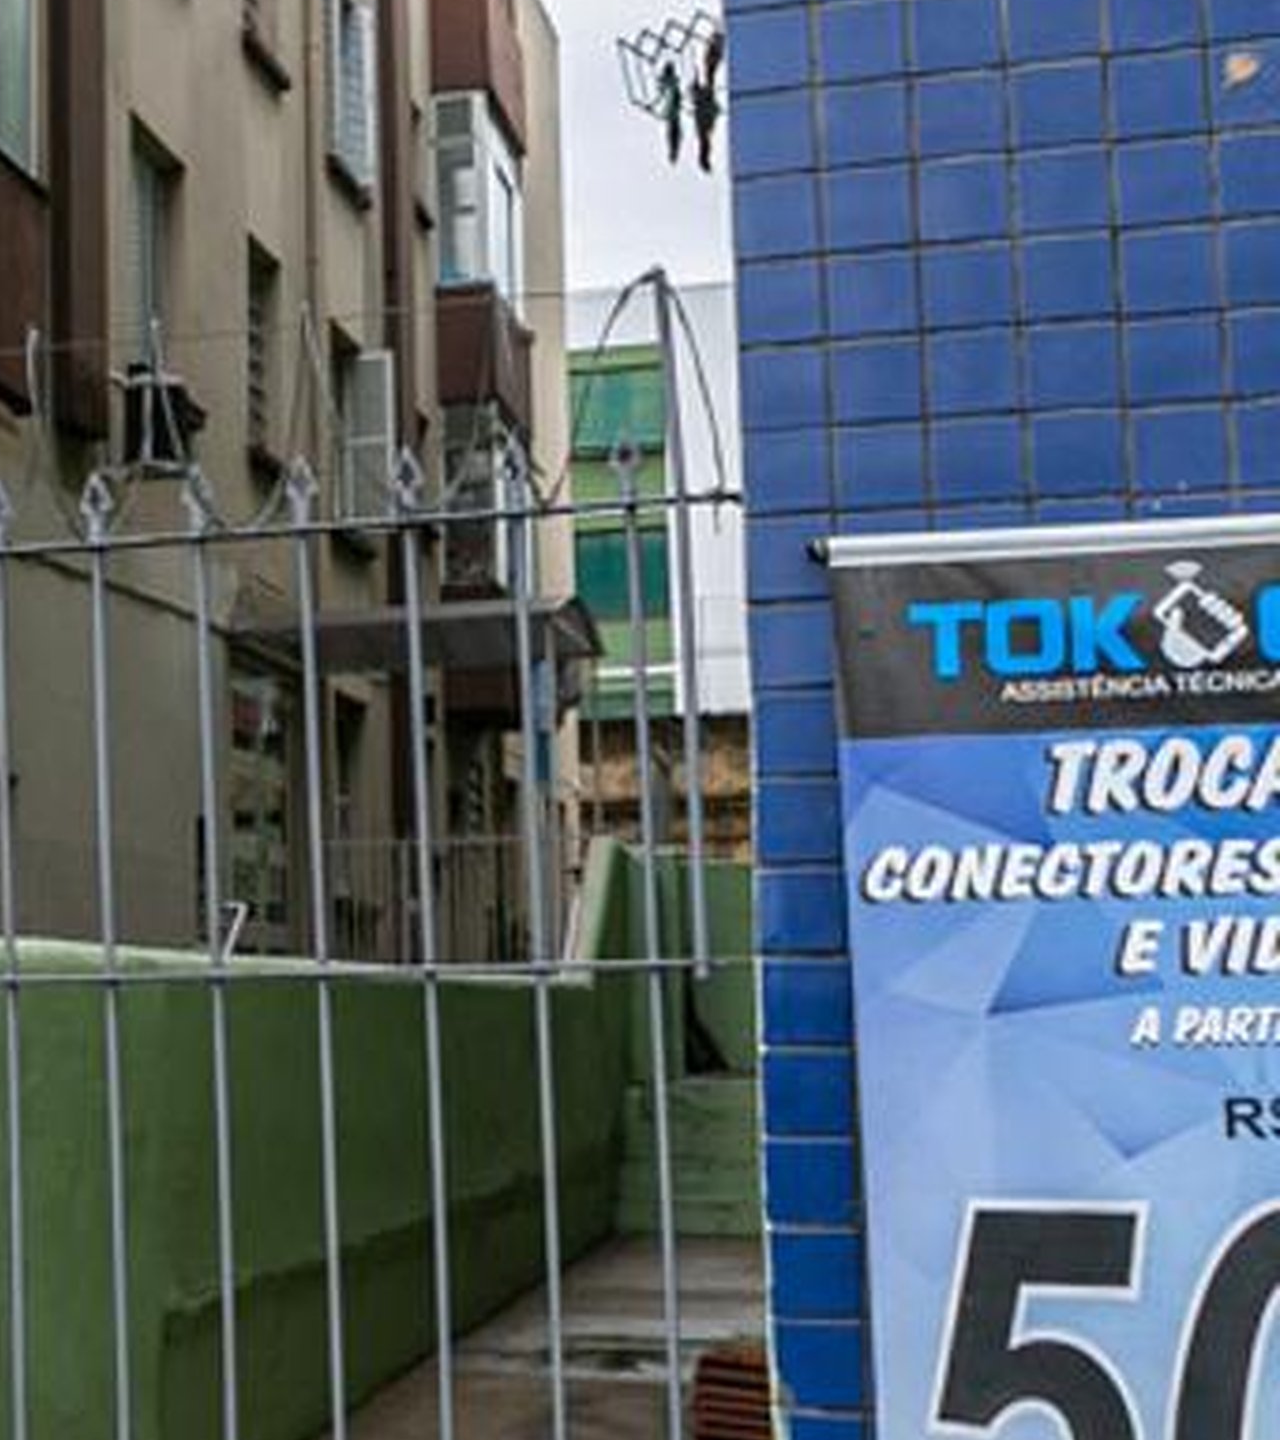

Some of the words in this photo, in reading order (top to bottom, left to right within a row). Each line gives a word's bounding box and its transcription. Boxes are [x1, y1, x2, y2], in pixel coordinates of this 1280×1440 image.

[907, 592, 1148, 680] TOK
[1114, 919, 1164, 977] E
[1129, 1006, 1162, 1048] A
